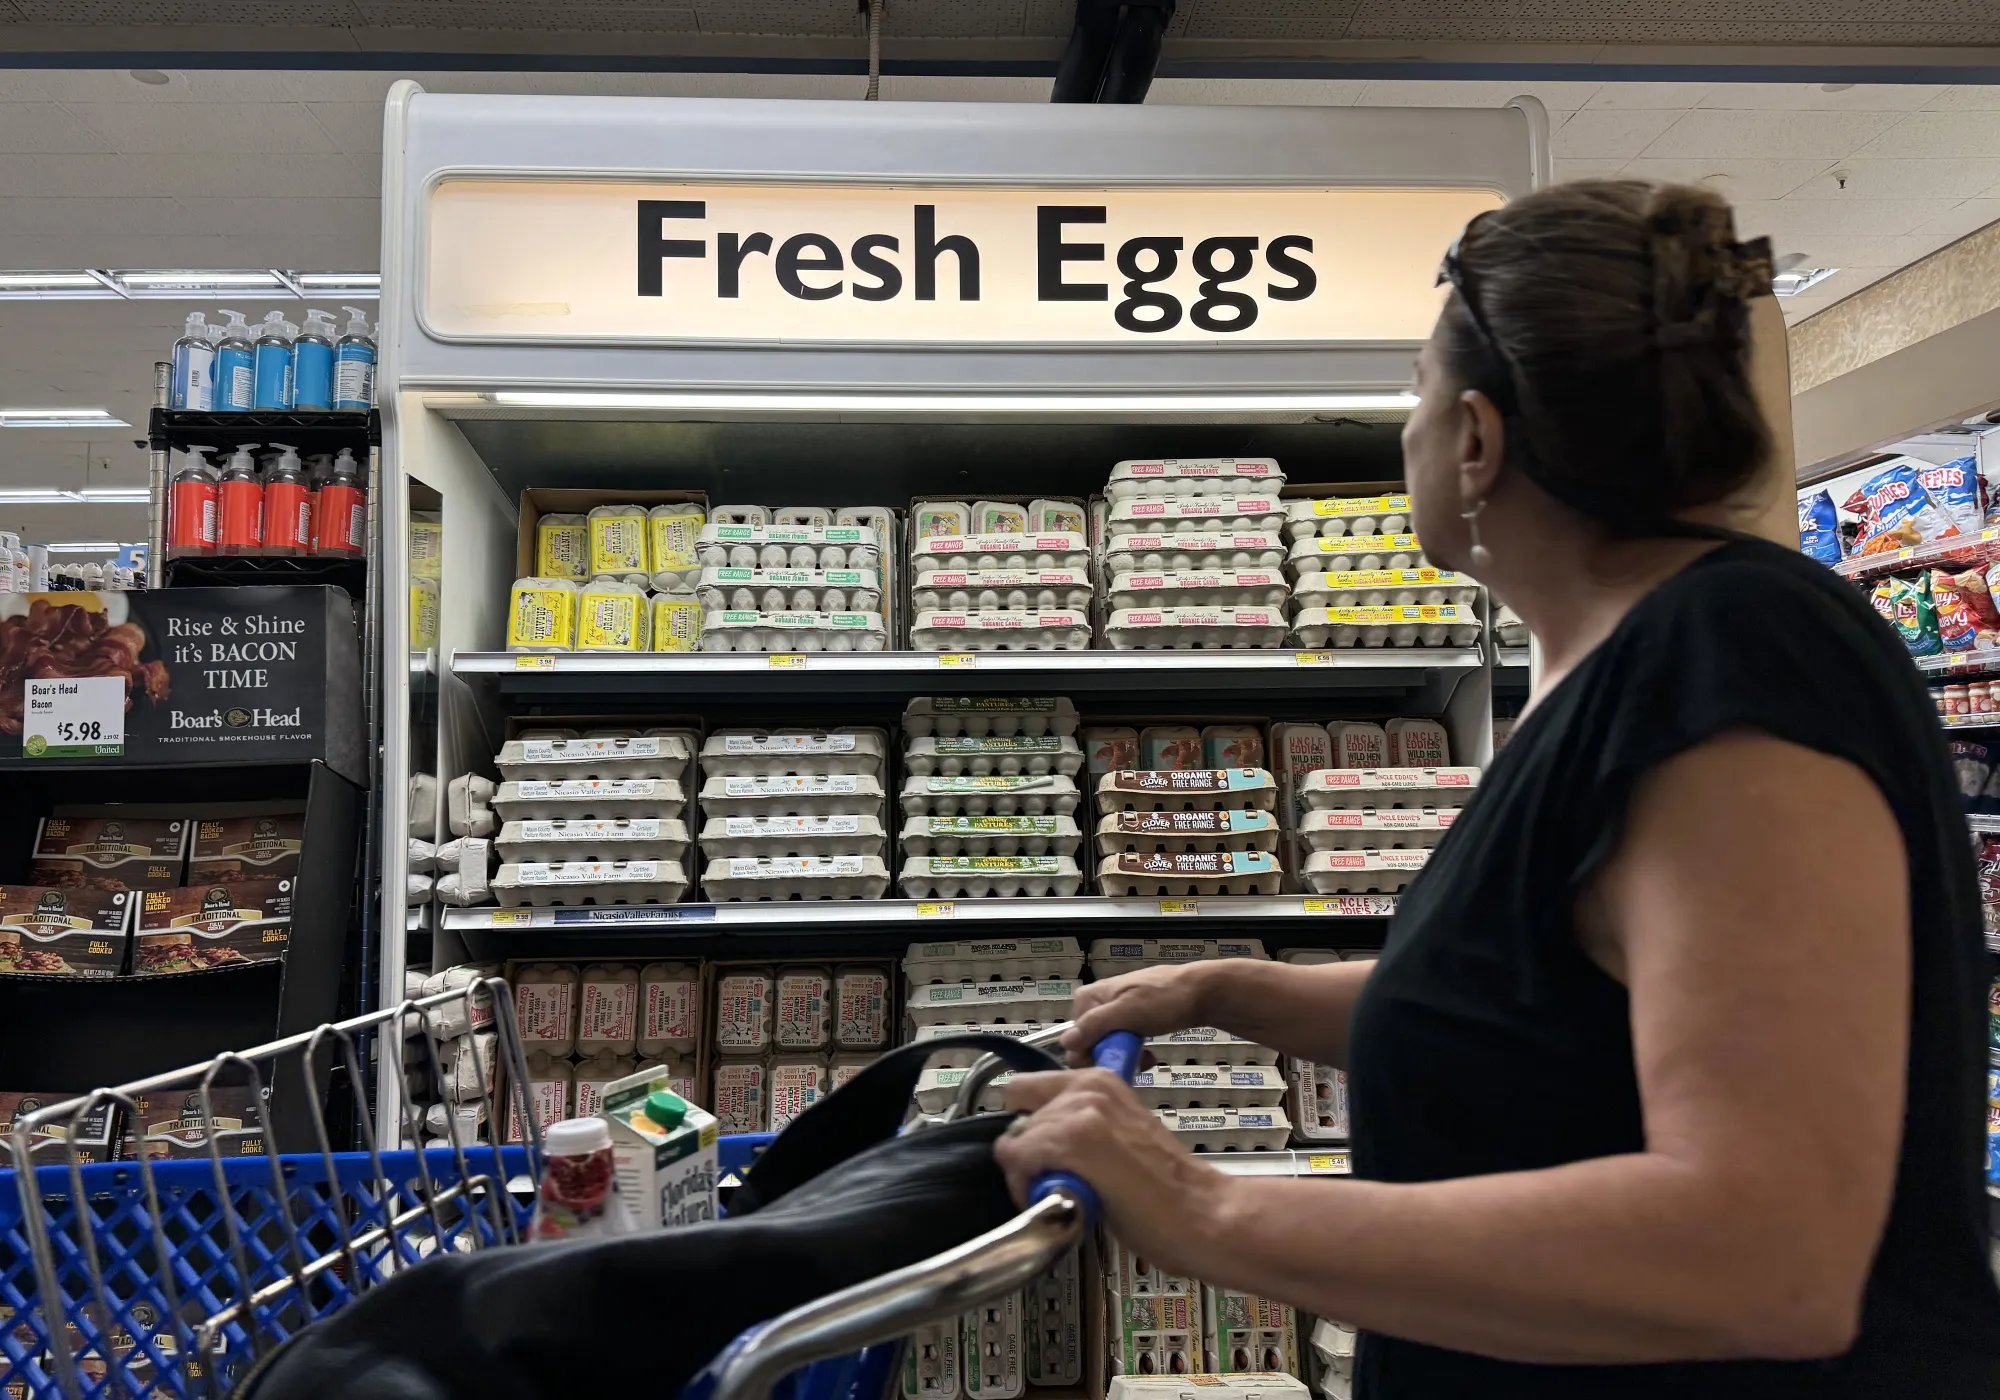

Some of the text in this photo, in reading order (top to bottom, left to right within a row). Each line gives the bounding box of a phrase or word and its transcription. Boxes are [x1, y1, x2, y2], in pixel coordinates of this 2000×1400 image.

[637, 199, 1317, 333] Fresh Eggs
[1131, 464, 1164, 473] FREE RANGE
[1132, 505, 1164, 514] FREE RANGE
[673, 521, 682, 553] ORGANIC
[718, 527, 751, 537] FREE RANGE
[612, 522, 621, 554] ORGANIC
[561, 531, 571, 562] ORGANIC
[930, 540, 963, 550] FREE RANGE
[603, 599, 615, 631] ORGANIC
[723, 613, 757, 621] FREE RANGE
[1143, 614, 1161, 622] RANGE
[167, 614, 305, 637] Rise & Shine
[535, 606, 546, 640] ORGANIC
[678, 607, 688, 639] ORGANIC
[948, 617, 965, 625] RANGE
[174, 641, 297, 663] it's BACON
[203, 669, 268, 689] TIME
[32, 683, 78, 695] Boar's Head
[31, 699, 52, 709] Bacon
[170, 707, 300, 729] Boar's Head
[57, 721, 101, 741] $5.98
[1405, 731, 1440, 741] UNCLE
[1289, 737, 1324, 746] UNCLE
[1346, 733, 1379, 743] UNCLE
[95, 745, 120, 754] United
[1407, 750, 1442, 759] WILD HEN
[1291, 755, 1325, 763] WILD HEN
[1347, 752, 1381, 761] WILD HEN
[1140, 777, 1168, 788] CLOVER
[1172, 779, 1213, 788] FREE RANGE
[1326, 775, 1360, 784] FREE RANGE
[1173, 813, 1214, 821] ORGANIC
[1329, 815, 1362, 824] FREE RANGE
[1141, 819, 1170, 829] CLOVER
[1174, 820, 1215, 829] FREE RANGE
[85, 844, 132, 852] TRADITIONAL
[241, 841, 287, 851] TRADITIONAL
[1175, 854, 1217, 862] ORGANIC
[1331, 856, 1365, 866] FREE RANGE
[1143, 860, 1172, 870] CLOVER
[1177, 862, 1218, 871] FREE RANGE
[145, 897, 171, 905] COOKED
[1340, 898, 1370, 907] NCLE
[23, 915, 72, 925] TRADITIONAL
[191, 911, 241, 923] TRADITIONAL
[262, 934, 287, 943] COOKED
[1303, 1071, 1311, 1092] JUMBO
